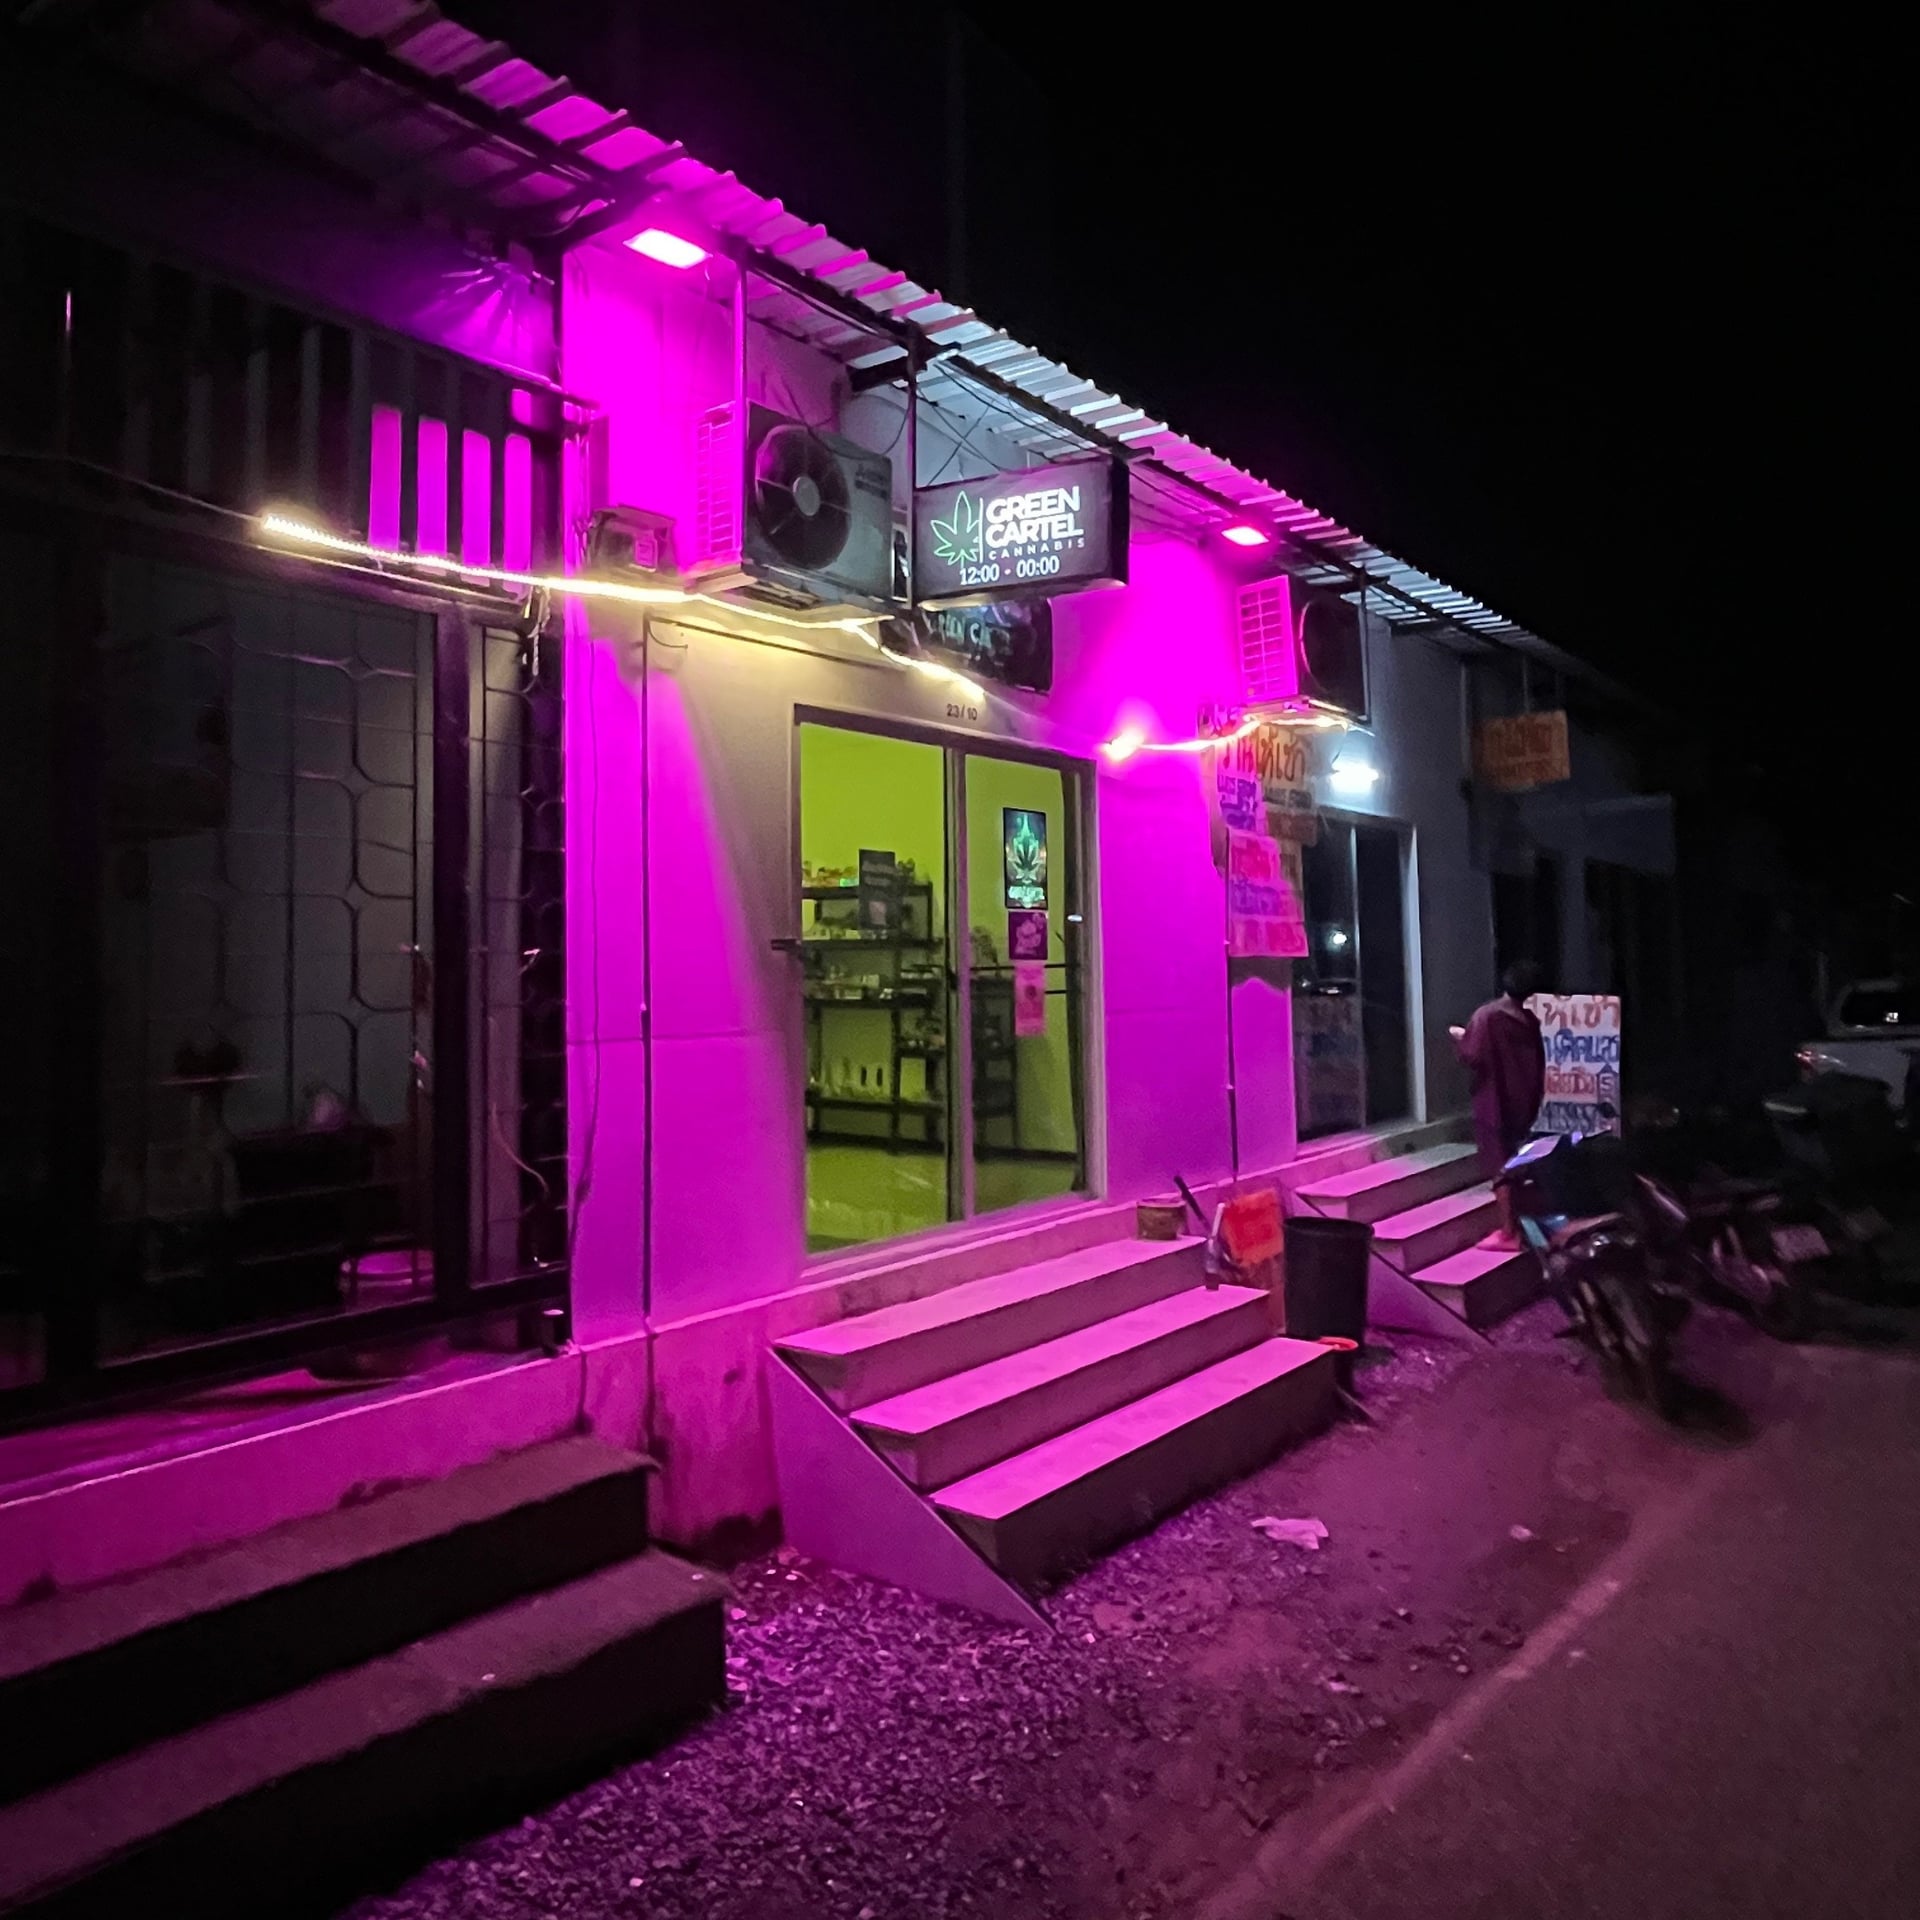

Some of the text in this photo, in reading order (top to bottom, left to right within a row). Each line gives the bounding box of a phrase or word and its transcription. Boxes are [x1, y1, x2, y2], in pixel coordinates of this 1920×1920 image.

[985, 486, 1081, 525] GREEN
[985, 513, 1084, 548] CARTEL
[988, 538, 1085, 560] CANNABIS
[959, 555, 1060, 586] 12:00 00:00
